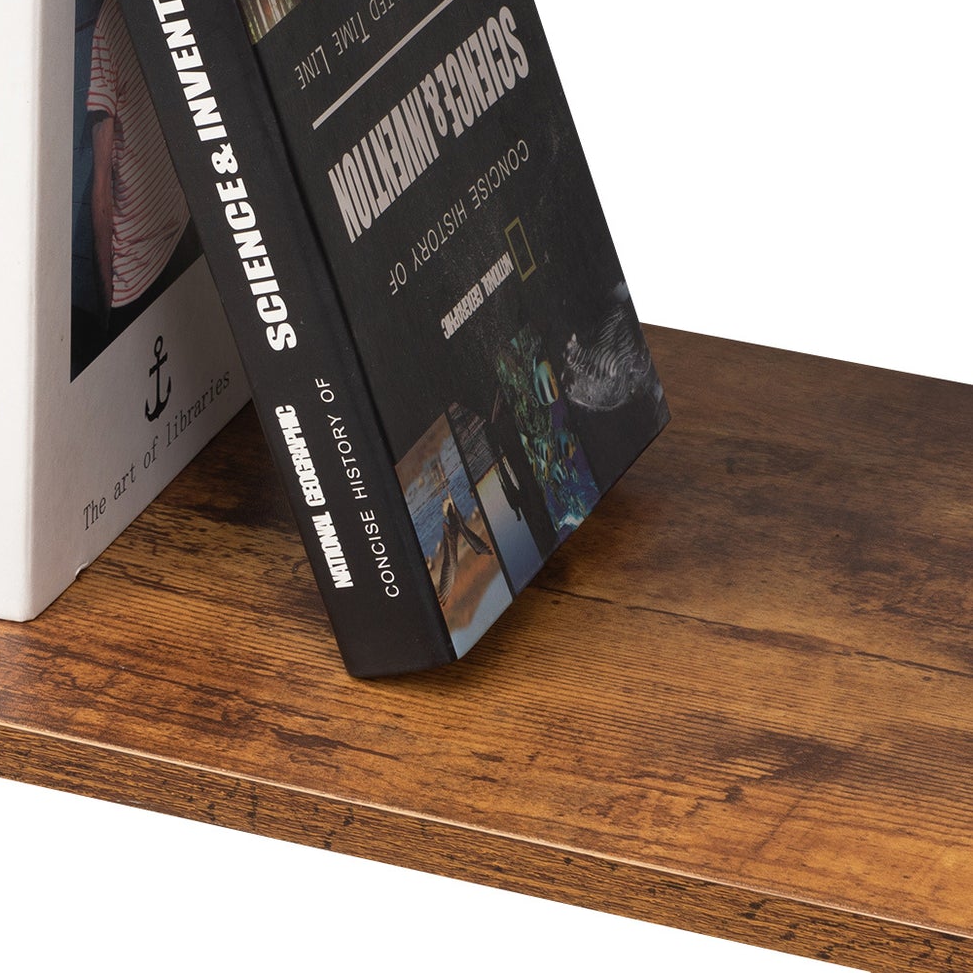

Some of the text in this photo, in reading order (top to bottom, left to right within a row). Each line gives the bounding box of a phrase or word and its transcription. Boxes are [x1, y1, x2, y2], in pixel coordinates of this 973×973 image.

[210, 142, 239, 175] &
[328, 5, 530, 244] SCIENCE & INVENTION
[215, 177, 298, 352] SCIENCE
[388, 139, 530, 296] CONCISE HISTORY OF
[440, 251, 515, 340] NATIONAL GEOGRAPHIC
[83, 370, 231, 532] The art of libraries
[274, 404, 355, 589] NATIONAL GEOGRAPHIC
[315, 378, 400, 598] CONCISE HISTORY OF
